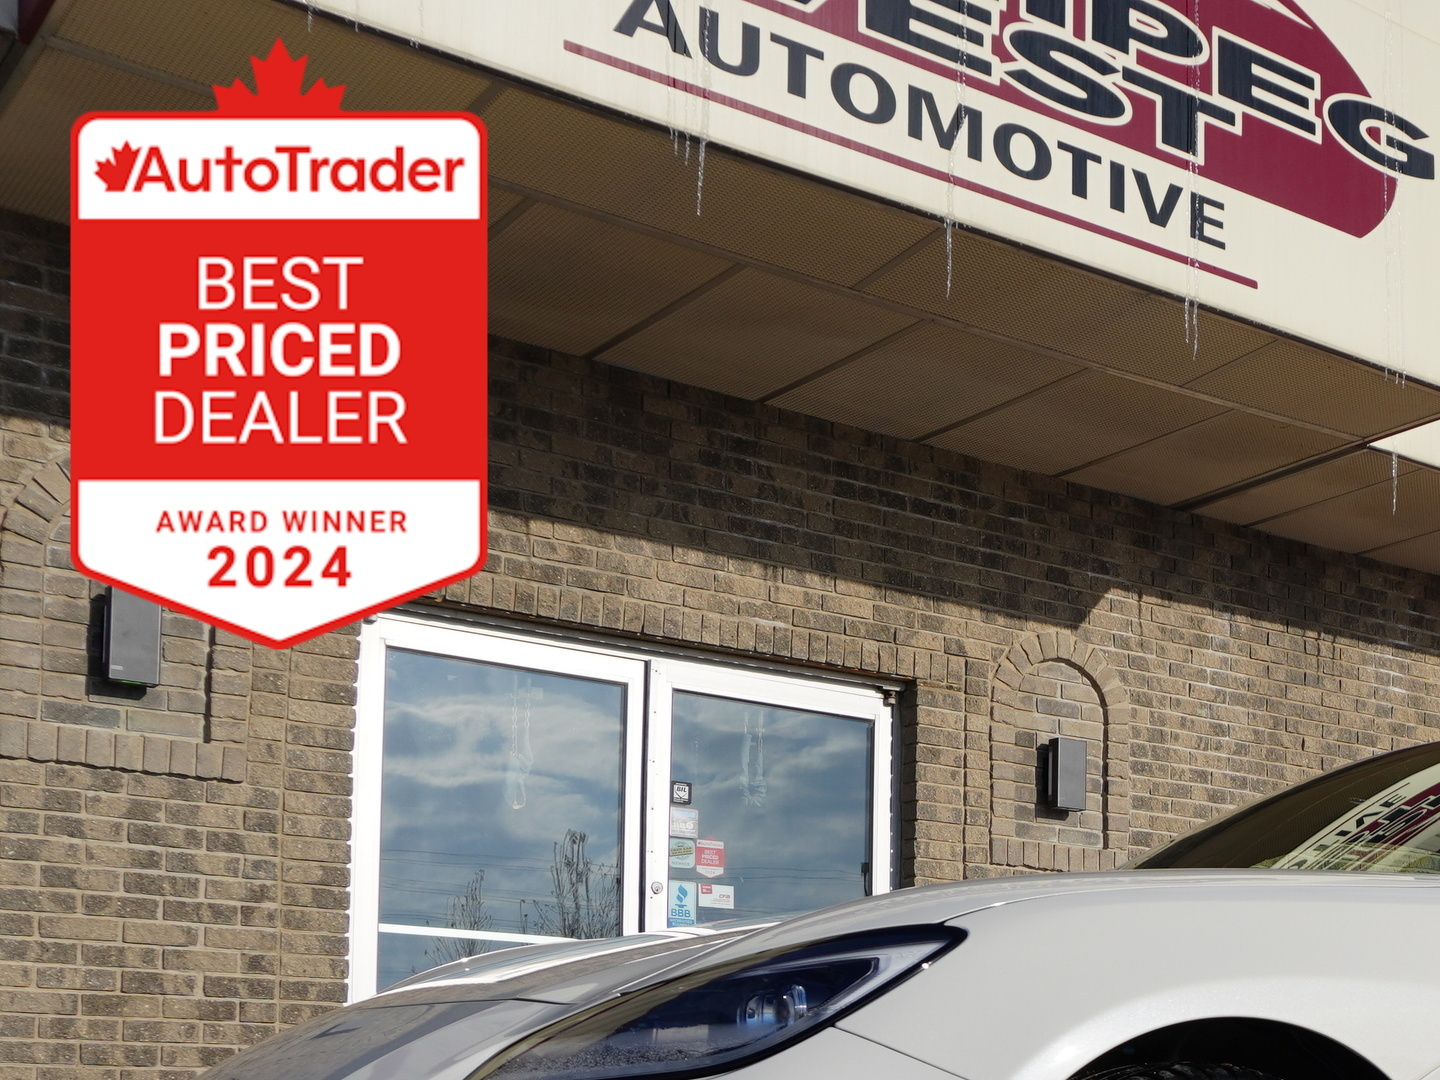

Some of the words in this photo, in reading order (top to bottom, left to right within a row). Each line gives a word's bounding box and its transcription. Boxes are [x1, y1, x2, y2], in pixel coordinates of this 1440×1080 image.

[613, 0, 1226, 250] AUTOMOTIVE
[792, 0, 1236, 157] EST
[671, 908, 691, 918] BBB
